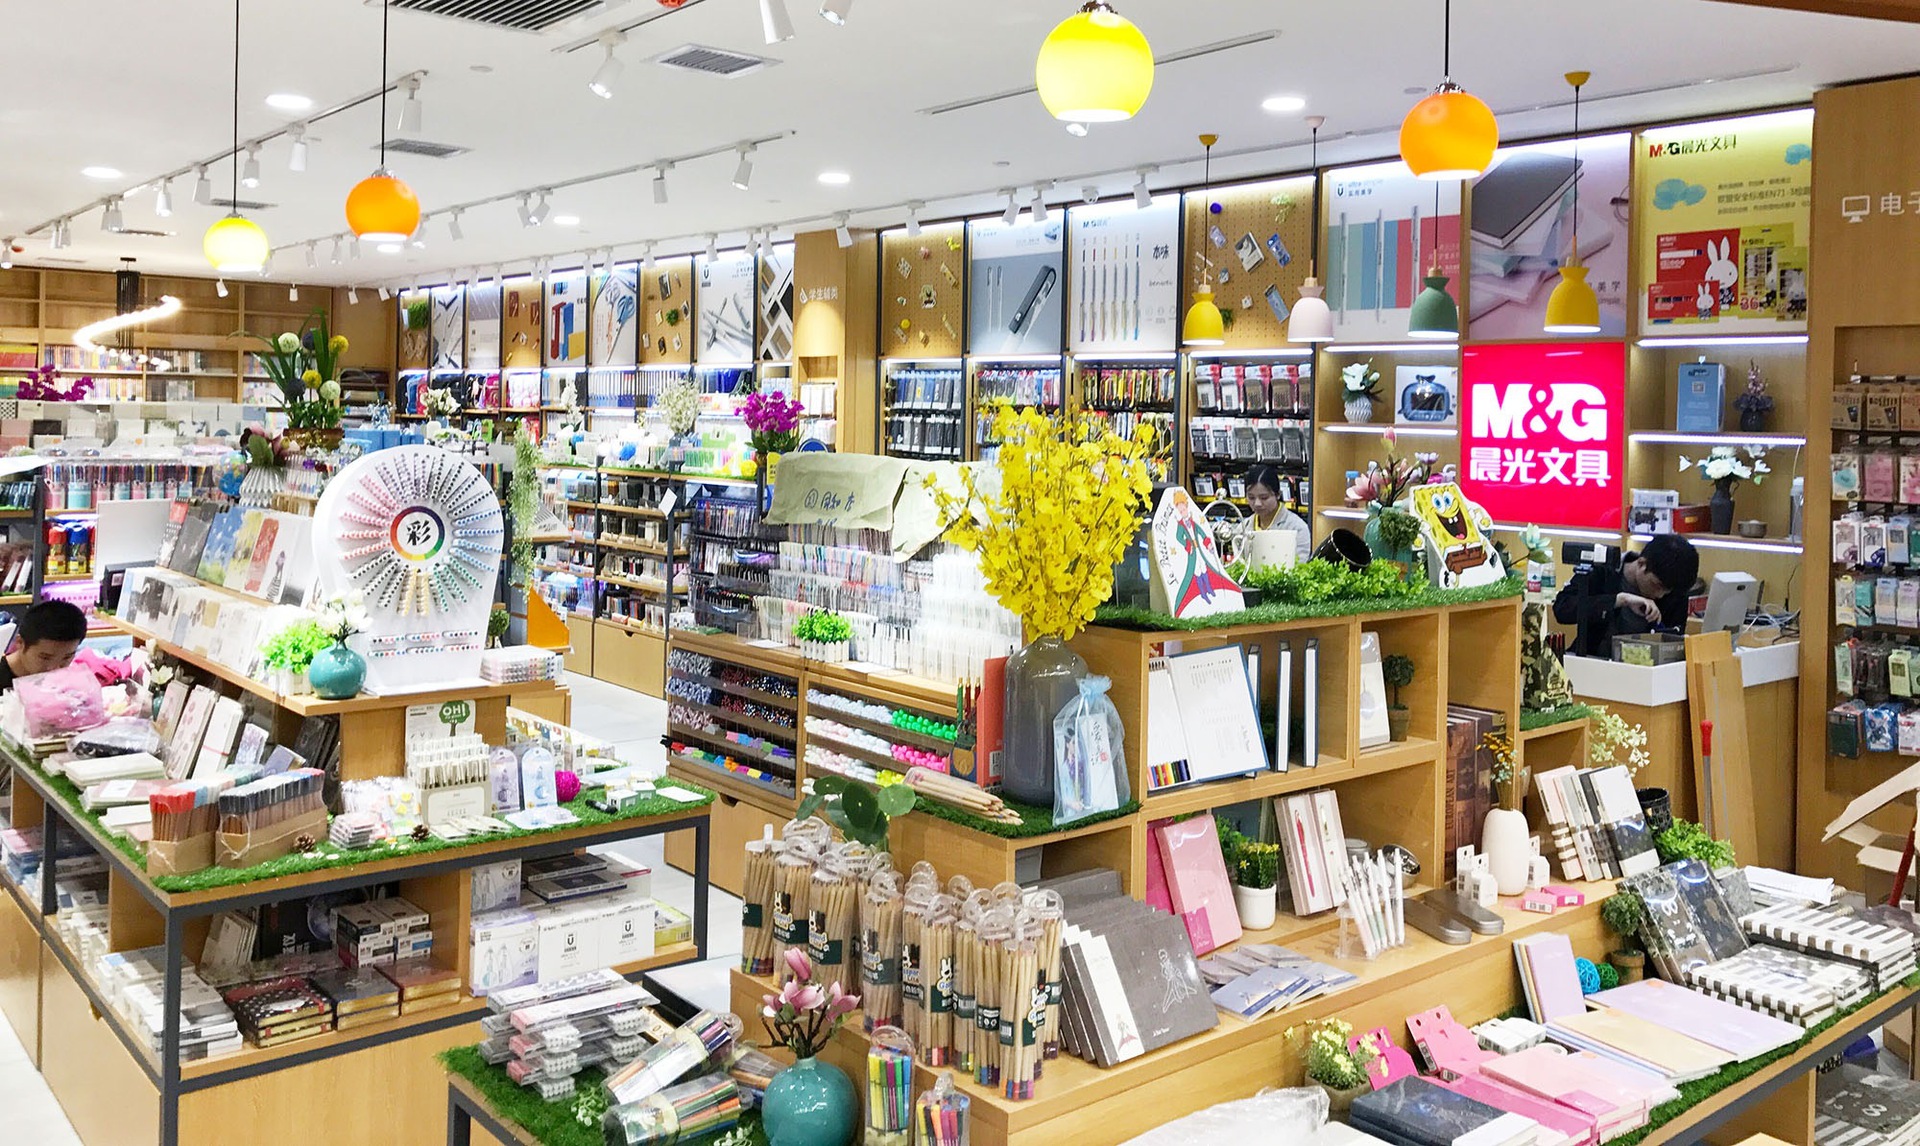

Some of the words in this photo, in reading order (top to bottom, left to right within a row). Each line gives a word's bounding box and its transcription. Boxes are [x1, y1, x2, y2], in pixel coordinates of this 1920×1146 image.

[1471, 383, 1608, 442] M&G
[1469, 446, 1612, 487] 晨光文具
[406, 520, 431, 546] 彩
[442, 703, 466, 717] OH!
[1446, 768, 1455, 784] ART
